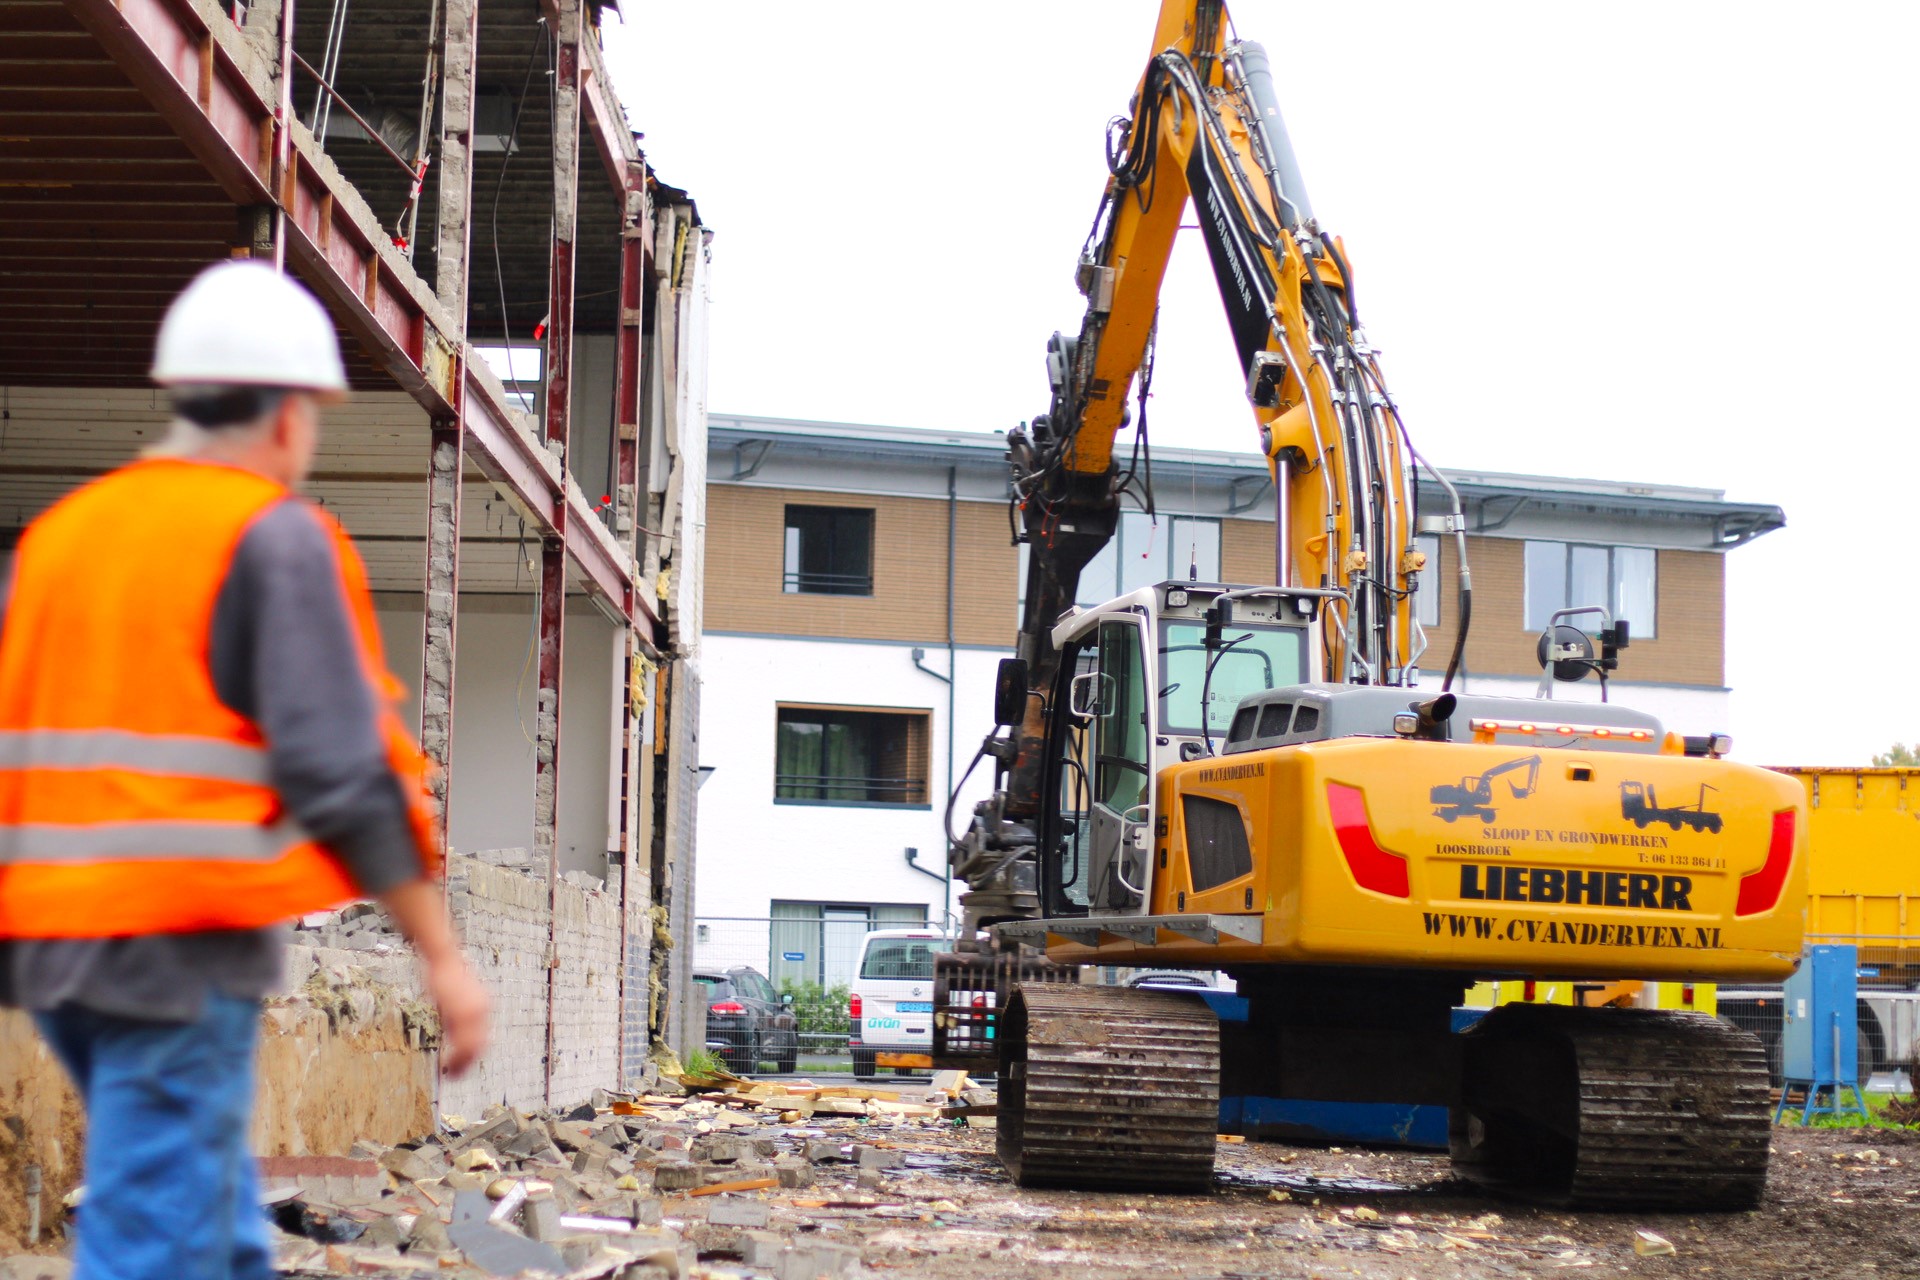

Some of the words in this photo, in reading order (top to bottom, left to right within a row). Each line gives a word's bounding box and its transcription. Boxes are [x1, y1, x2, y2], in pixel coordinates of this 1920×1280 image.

[1199, 762, 1265, 783] WWW.CVANDERVEN.NL
[1482, 827, 1531, 842] SLOOP
[1535, 830, 1554, 844] EN
[1559, 831, 1669, 849] GRONDWERKEN
[1436, 844, 1512, 857] LOOSBROEK
[1638, 853, 1648, 863] T:
[1652, 854, 1666, 864] 06
[1670, 855, 1689, 866] 133
[1692, 857, 1711, 868] 864
[1459, 864, 1693, 911] LIEBHERR
[1422, 912, 1725, 949] WWW.CVANDERVEN.NL
